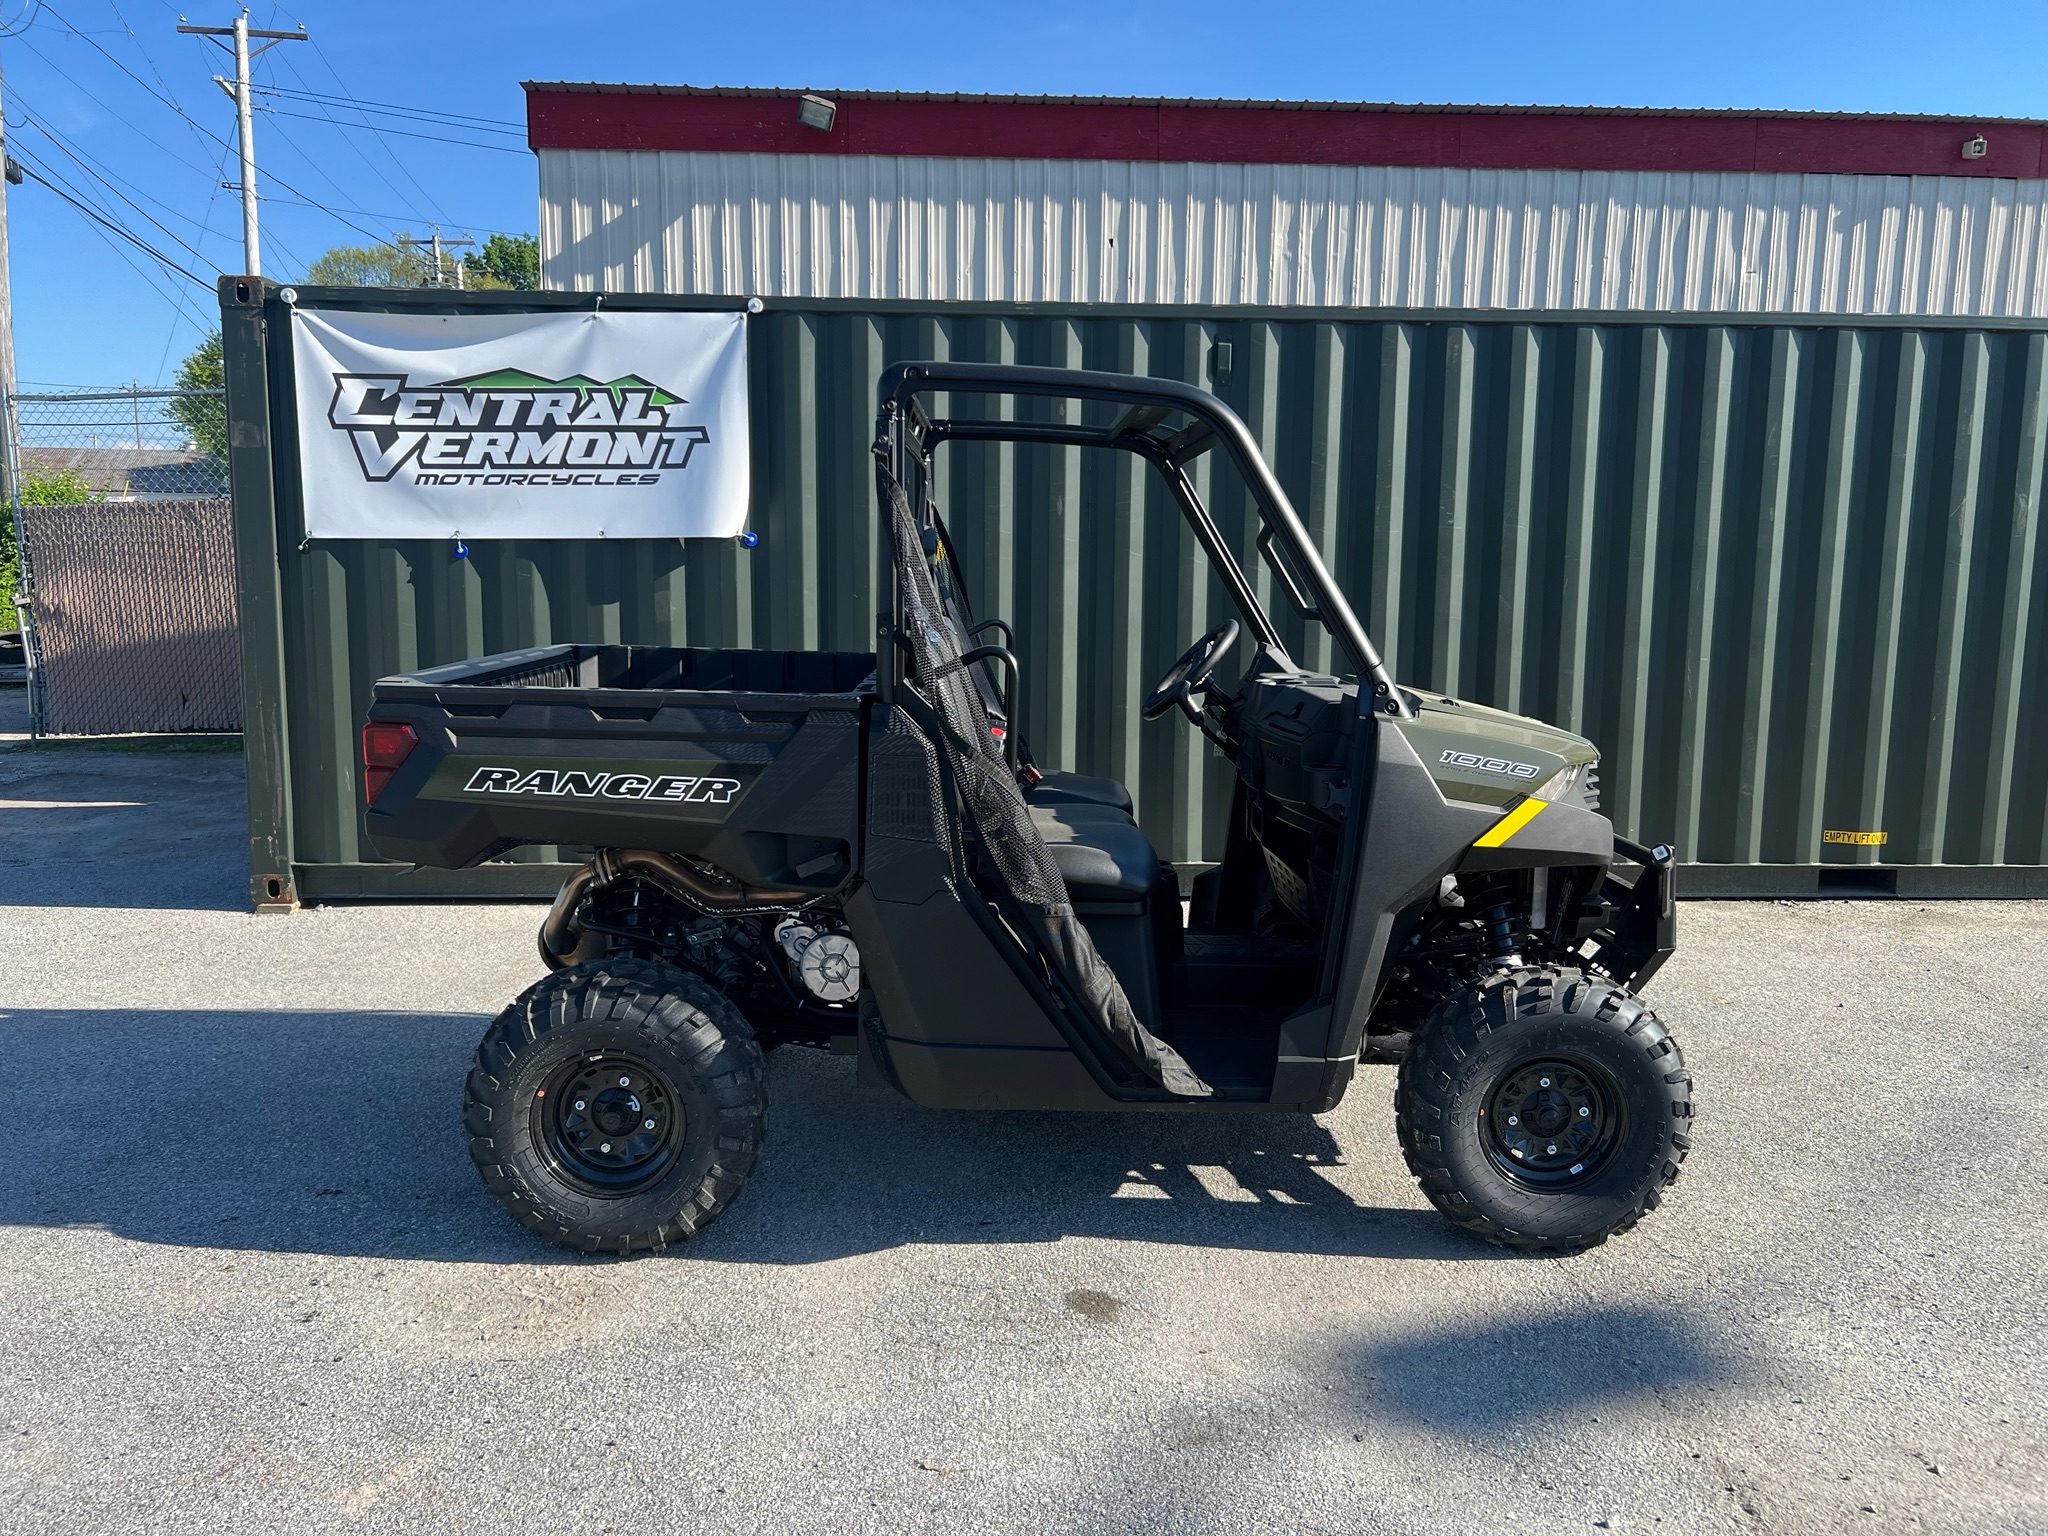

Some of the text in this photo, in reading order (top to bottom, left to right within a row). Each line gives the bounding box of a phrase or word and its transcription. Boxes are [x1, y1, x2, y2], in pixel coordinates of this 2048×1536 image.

[328, 372, 670, 427] CENTRAL
[348, 426, 710, 482] VERMONT
[414, 473, 661, 486] MOTORCYCLES
[1439, 750, 1540, 778] 1000
[463, 767, 741, 803] RANGER
[1824, 832, 1852, 843] EMPTY
[1854, 833, 1871, 844] LIFT
